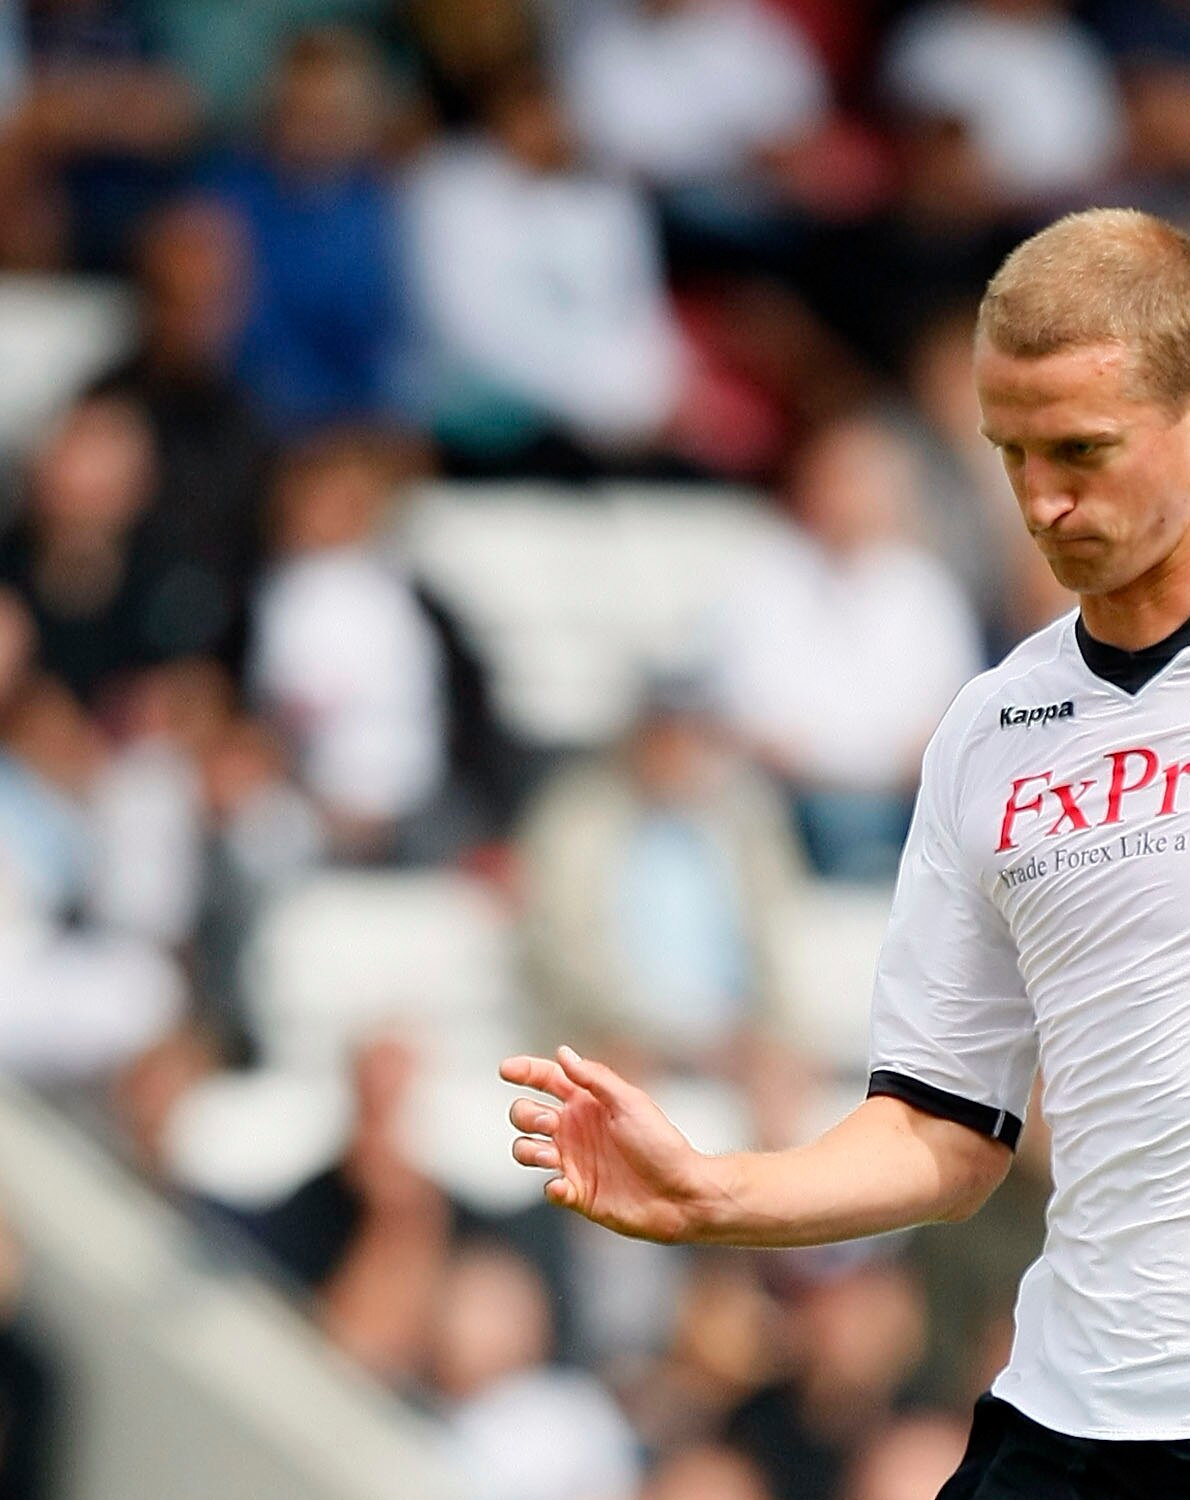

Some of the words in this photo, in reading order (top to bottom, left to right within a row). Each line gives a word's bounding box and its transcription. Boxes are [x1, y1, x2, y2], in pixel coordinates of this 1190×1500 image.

[1000, 701, 1074, 729] Kappa
[1054, 846, 1113, 872] Forex
[1120, 831, 1168, 858] Like
[1174, 833, 1186, 852] a
